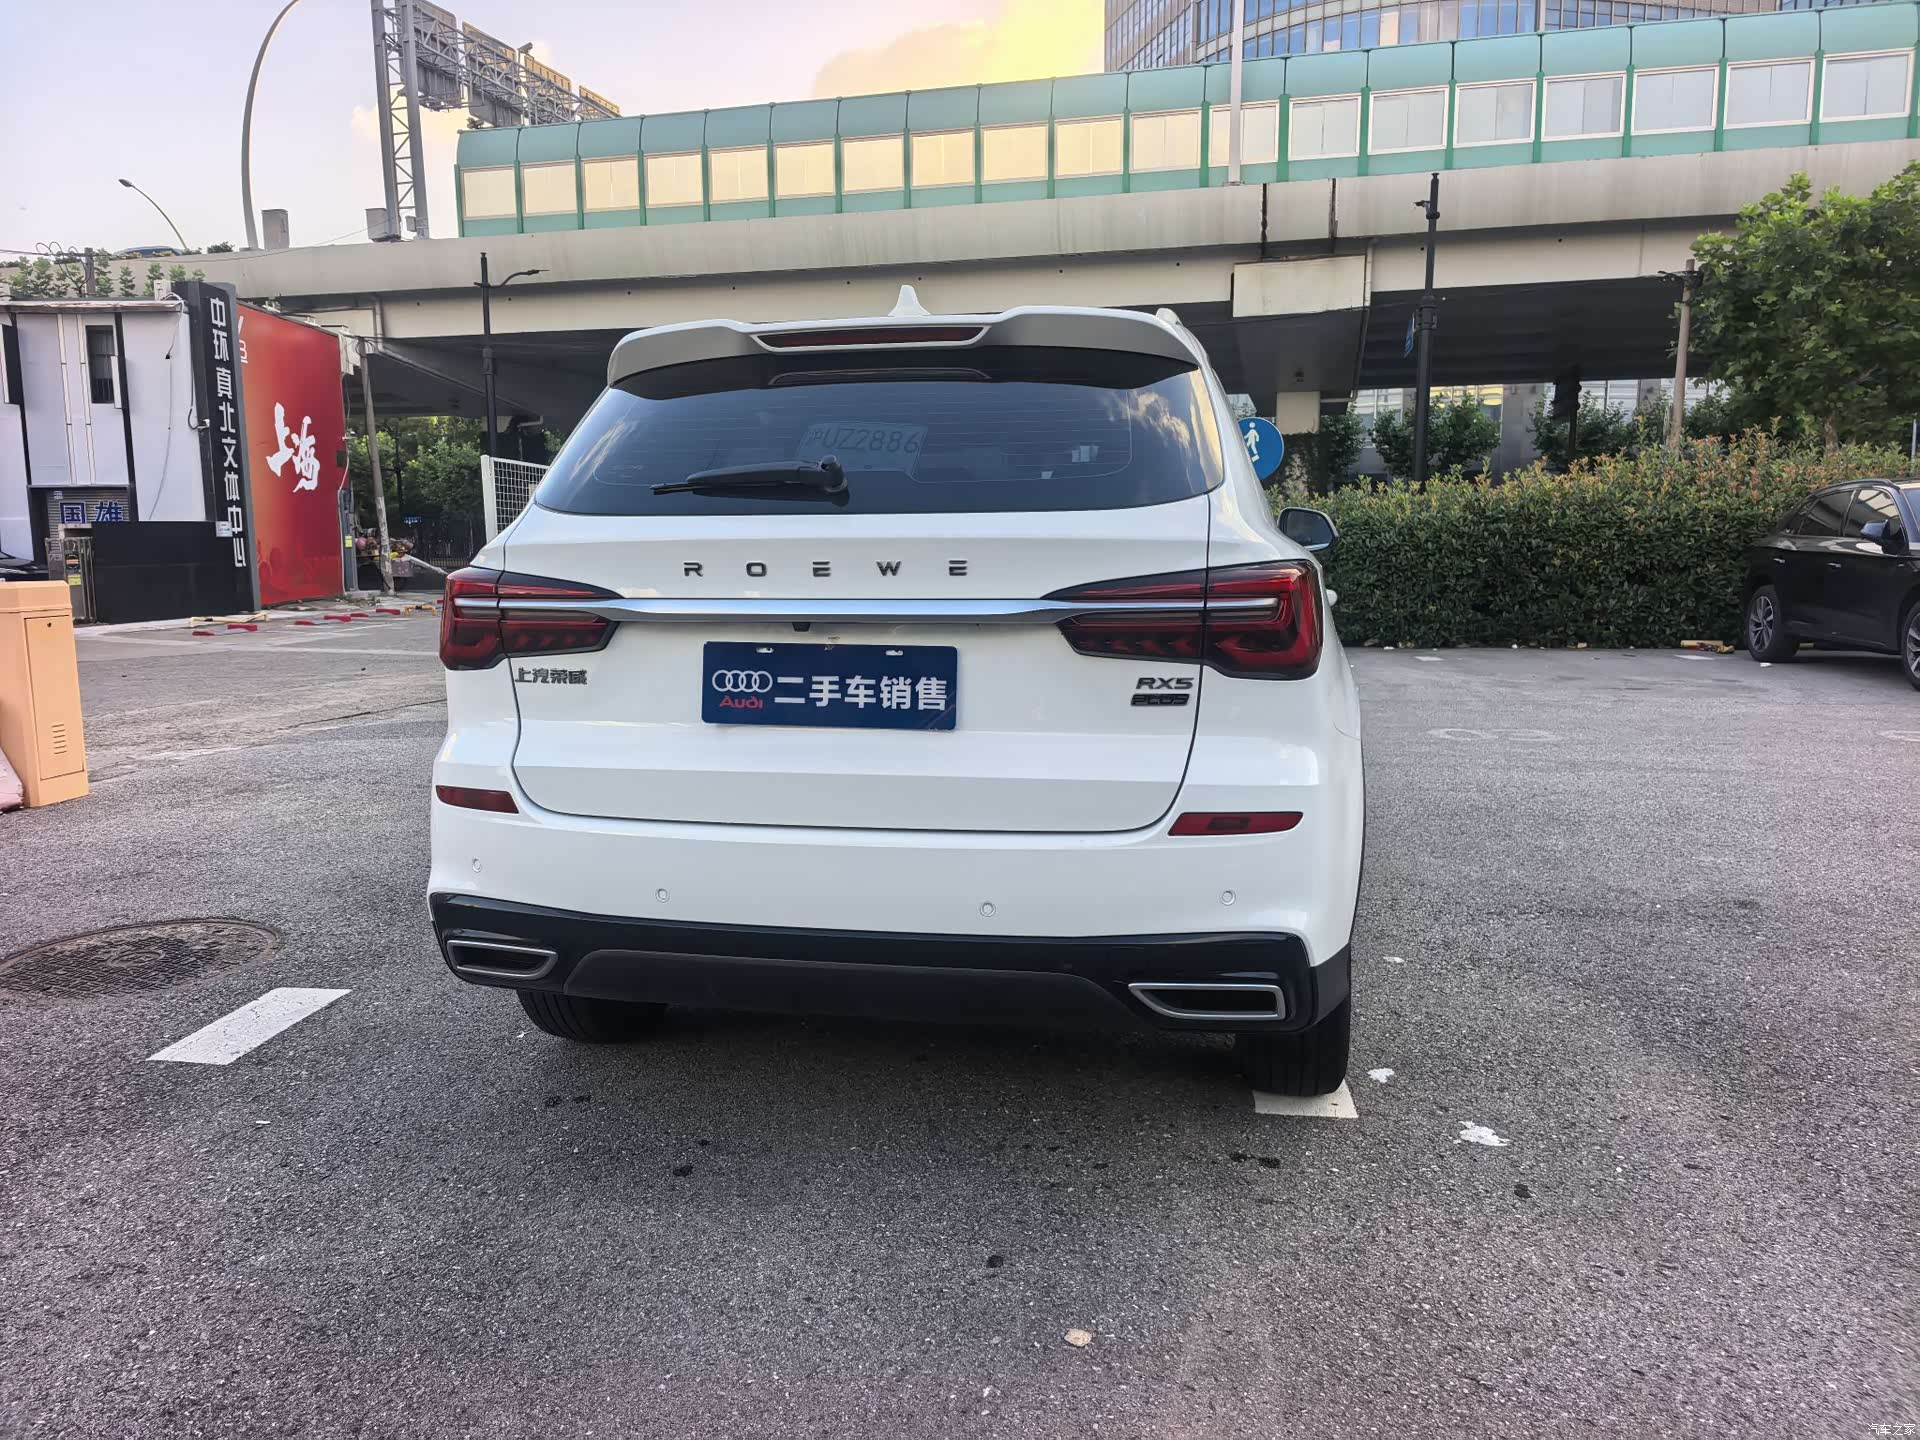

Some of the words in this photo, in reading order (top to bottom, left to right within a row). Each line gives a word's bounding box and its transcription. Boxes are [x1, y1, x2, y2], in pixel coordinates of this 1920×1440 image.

[210, 297, 246, 567] 中环真北文体中心
[266, 402, 320, 492] 上海
[683, 560, 968, 577] ROEWE
[514, 667, 588, 685] 上汽荣威
[1135, 677, 1195, 689] RX5
[719, 695, 764, 709] Audi
[774, 675, 948, 711] 二手车销售
